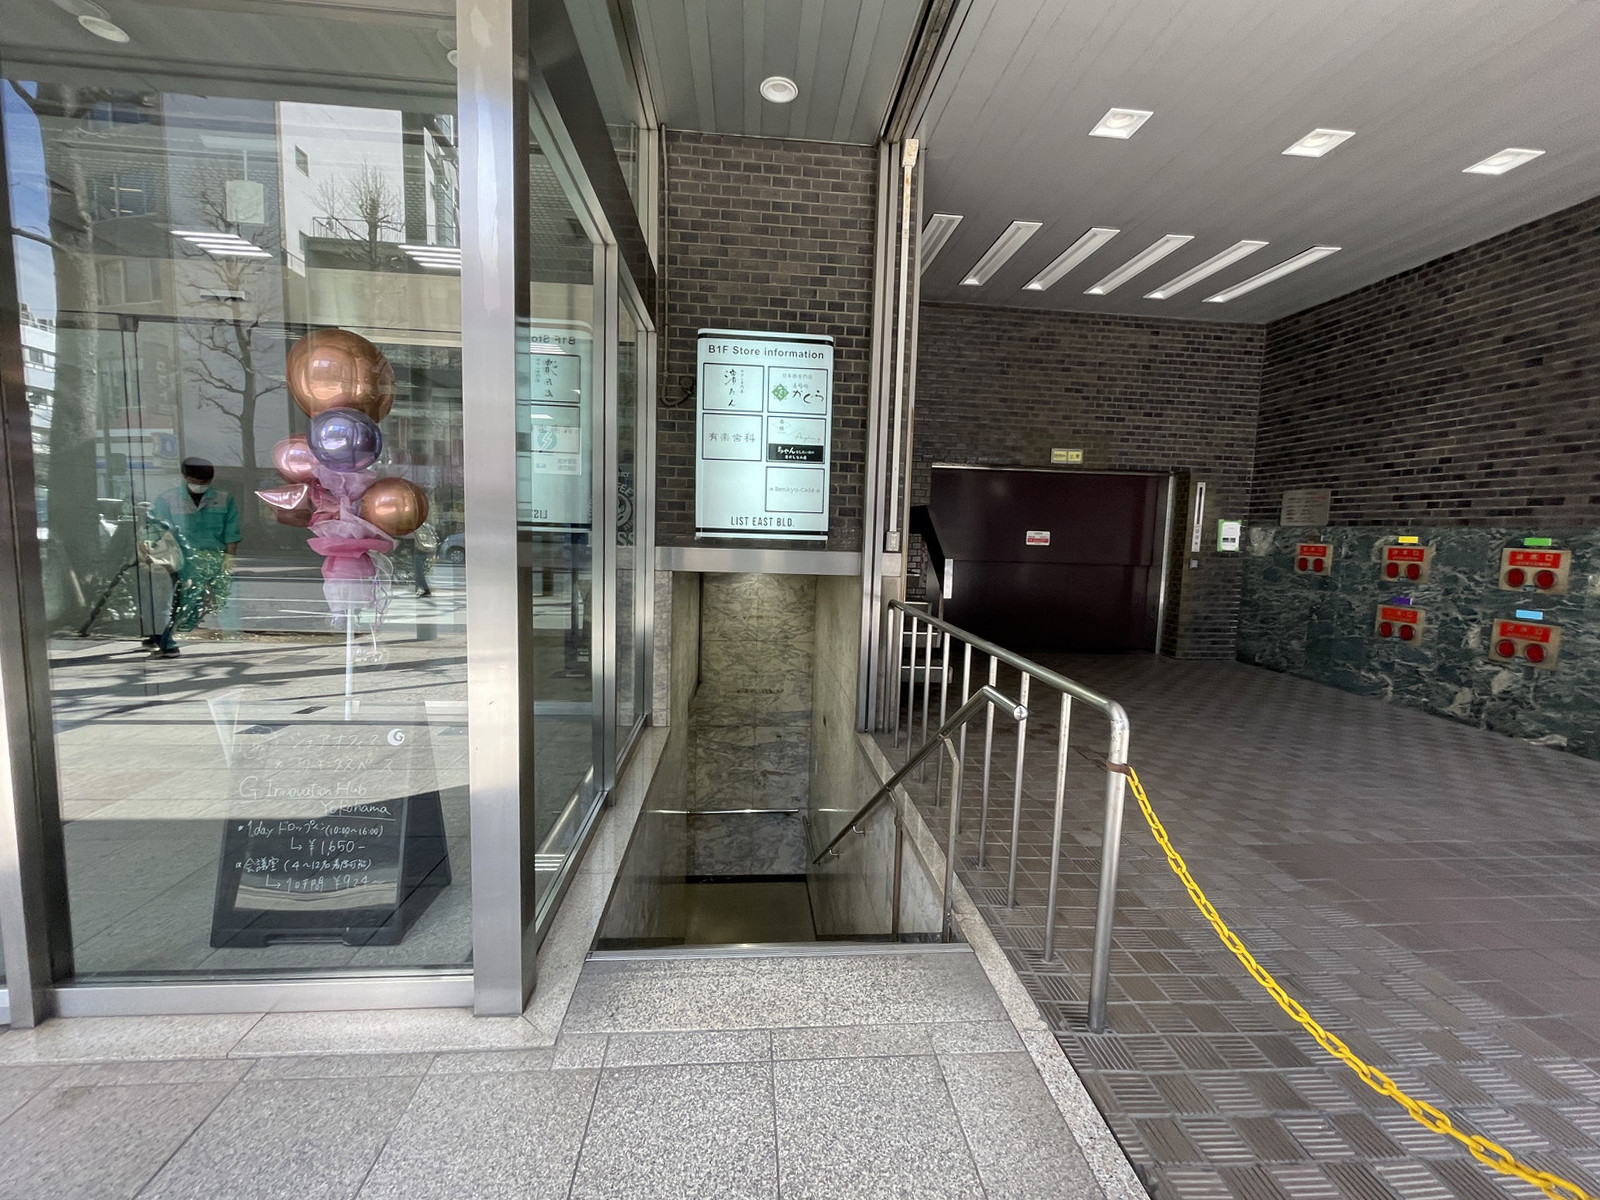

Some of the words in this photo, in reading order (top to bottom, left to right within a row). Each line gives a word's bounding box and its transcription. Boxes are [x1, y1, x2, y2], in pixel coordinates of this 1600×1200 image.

[708, 344, 728, 354] B1F
[732, 345, 760, 356] Store
[764, 347, 824, 359] information
[731, 516, 749, 526] LIST
[752, 517, 773, 527] EAST
[776, 517, 795, 527] BLD.
[238, 775, 258, 800] G
[335, 781, 367, 797] Hub
[320, 799, 393, 816] Yokohama
[247, 819, 274, 838] 1day
[244, 857, 280, 873] 会議室
